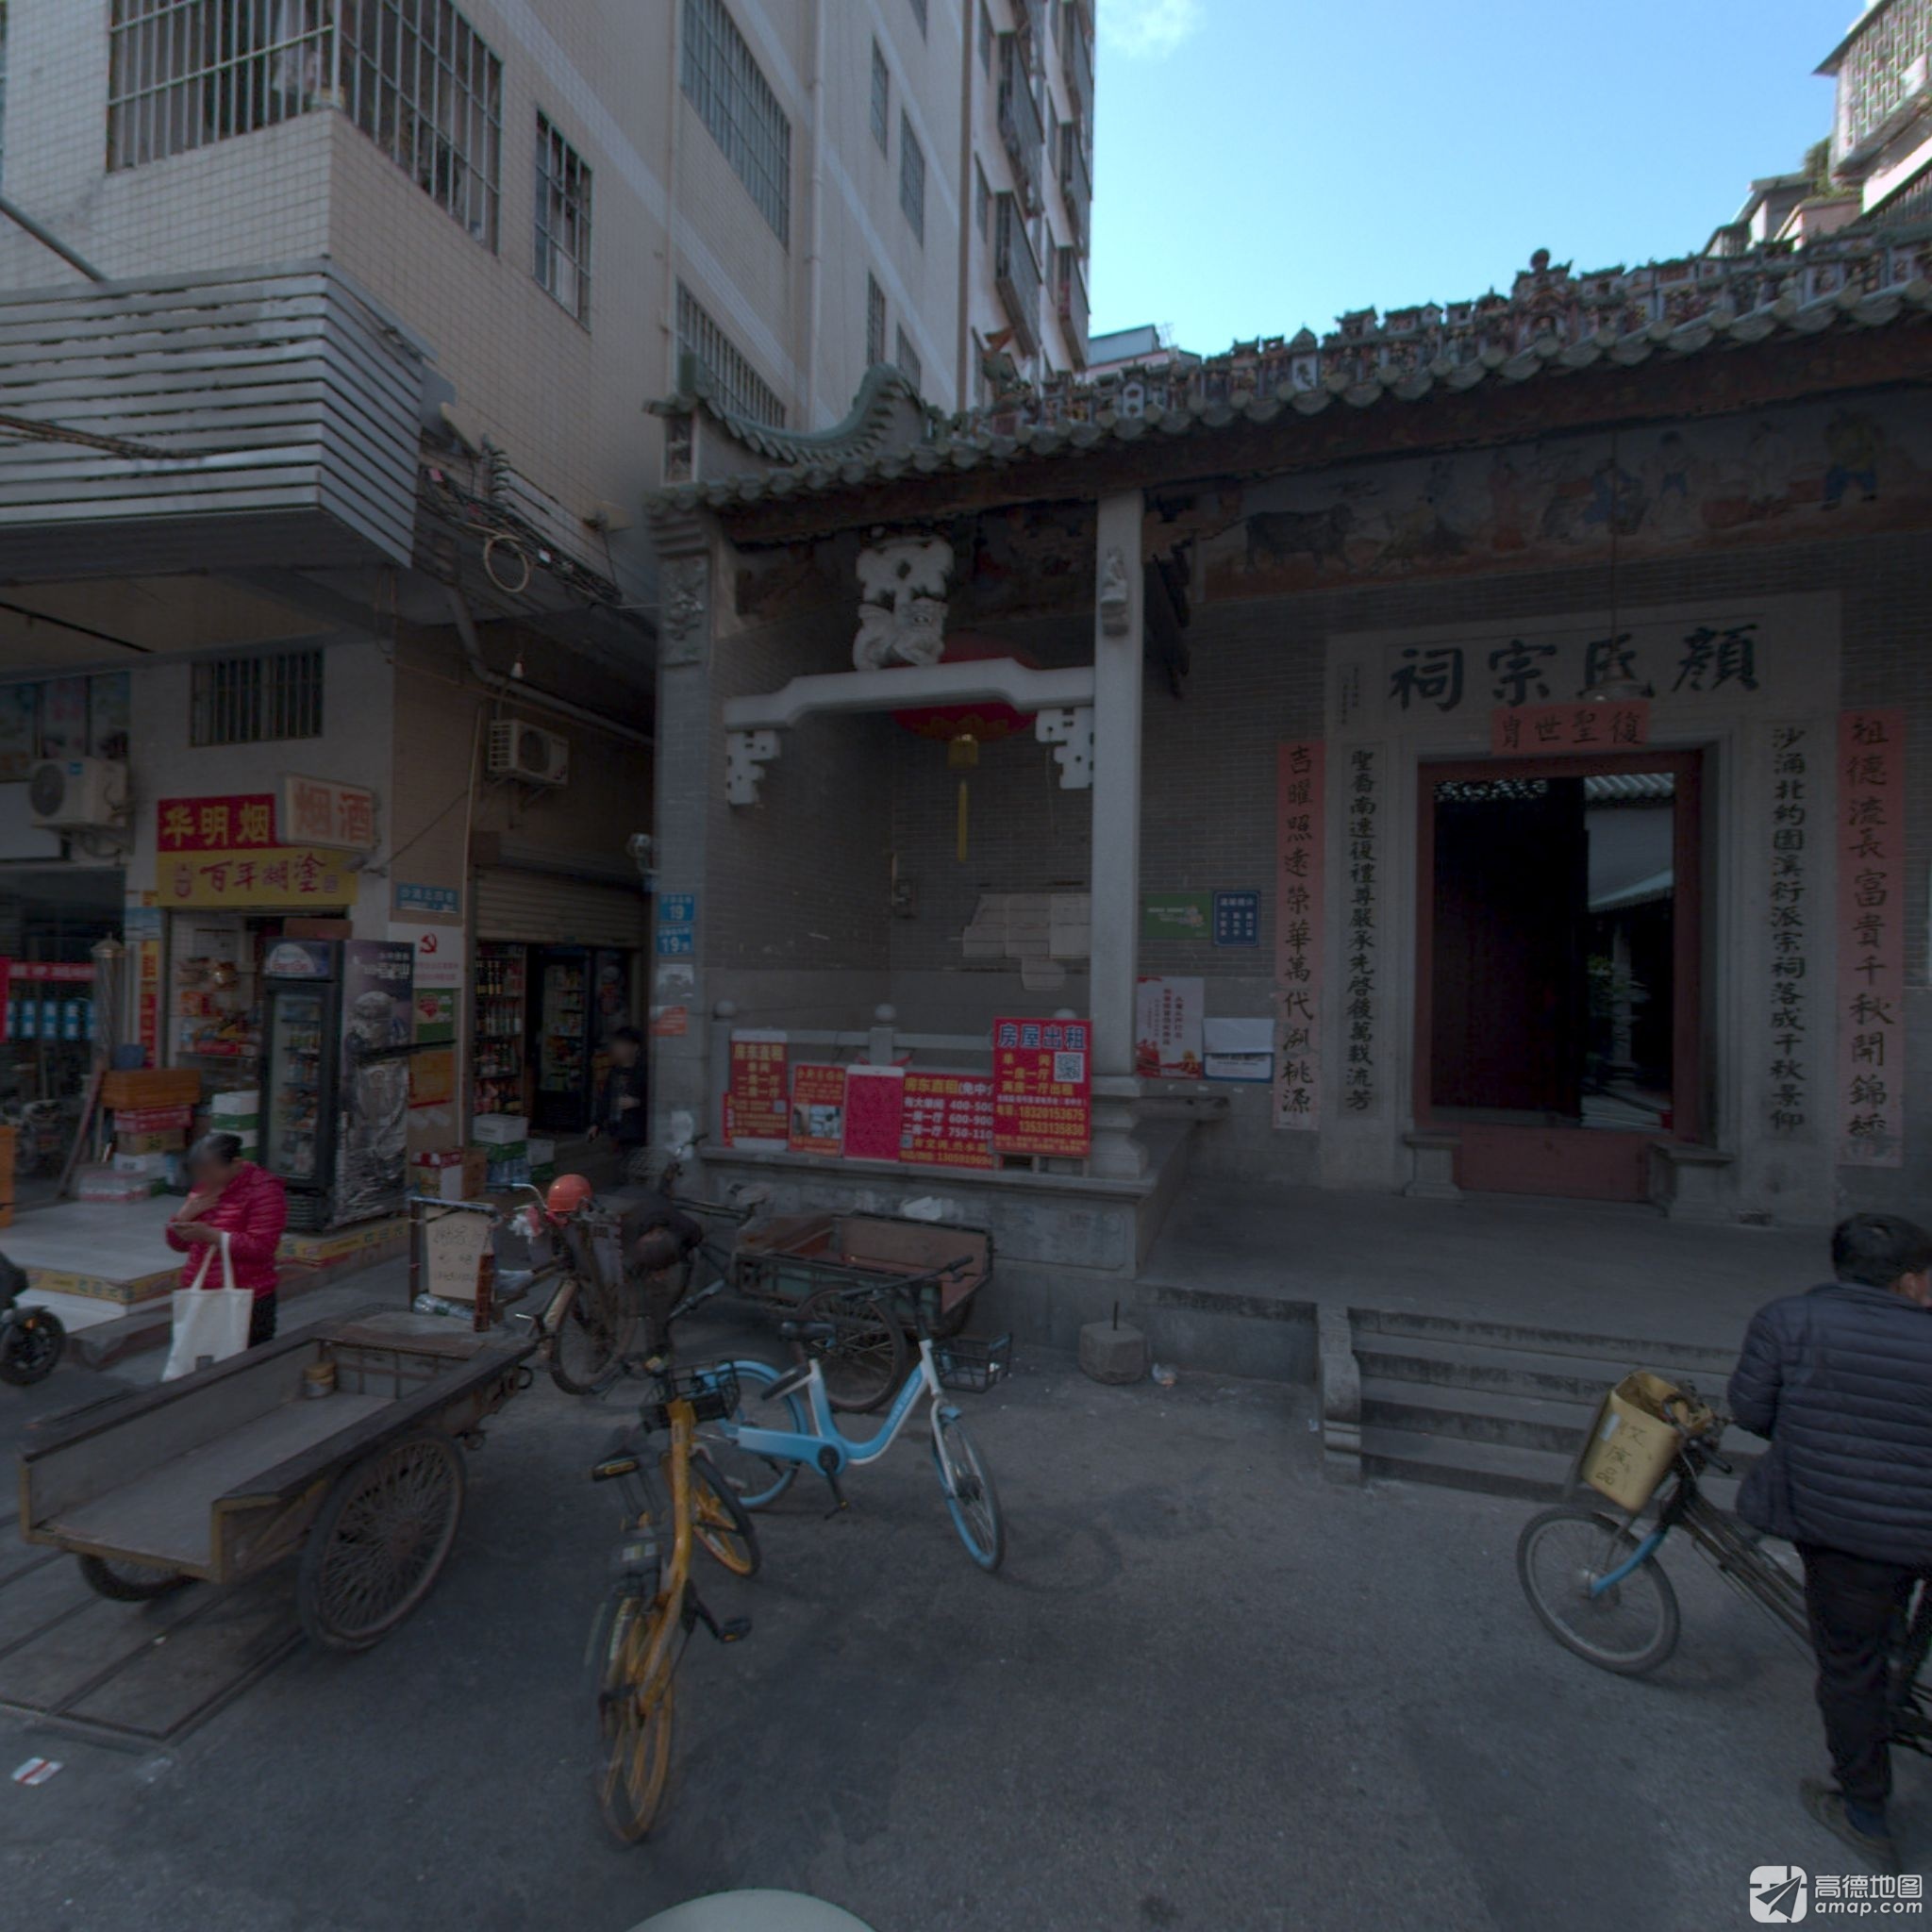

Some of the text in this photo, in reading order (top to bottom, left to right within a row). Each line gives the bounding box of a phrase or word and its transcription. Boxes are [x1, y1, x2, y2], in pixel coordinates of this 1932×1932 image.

[162, 803, 271, 847] 华明烟
[999, 1023, 1086, 1050] 房屋出租
